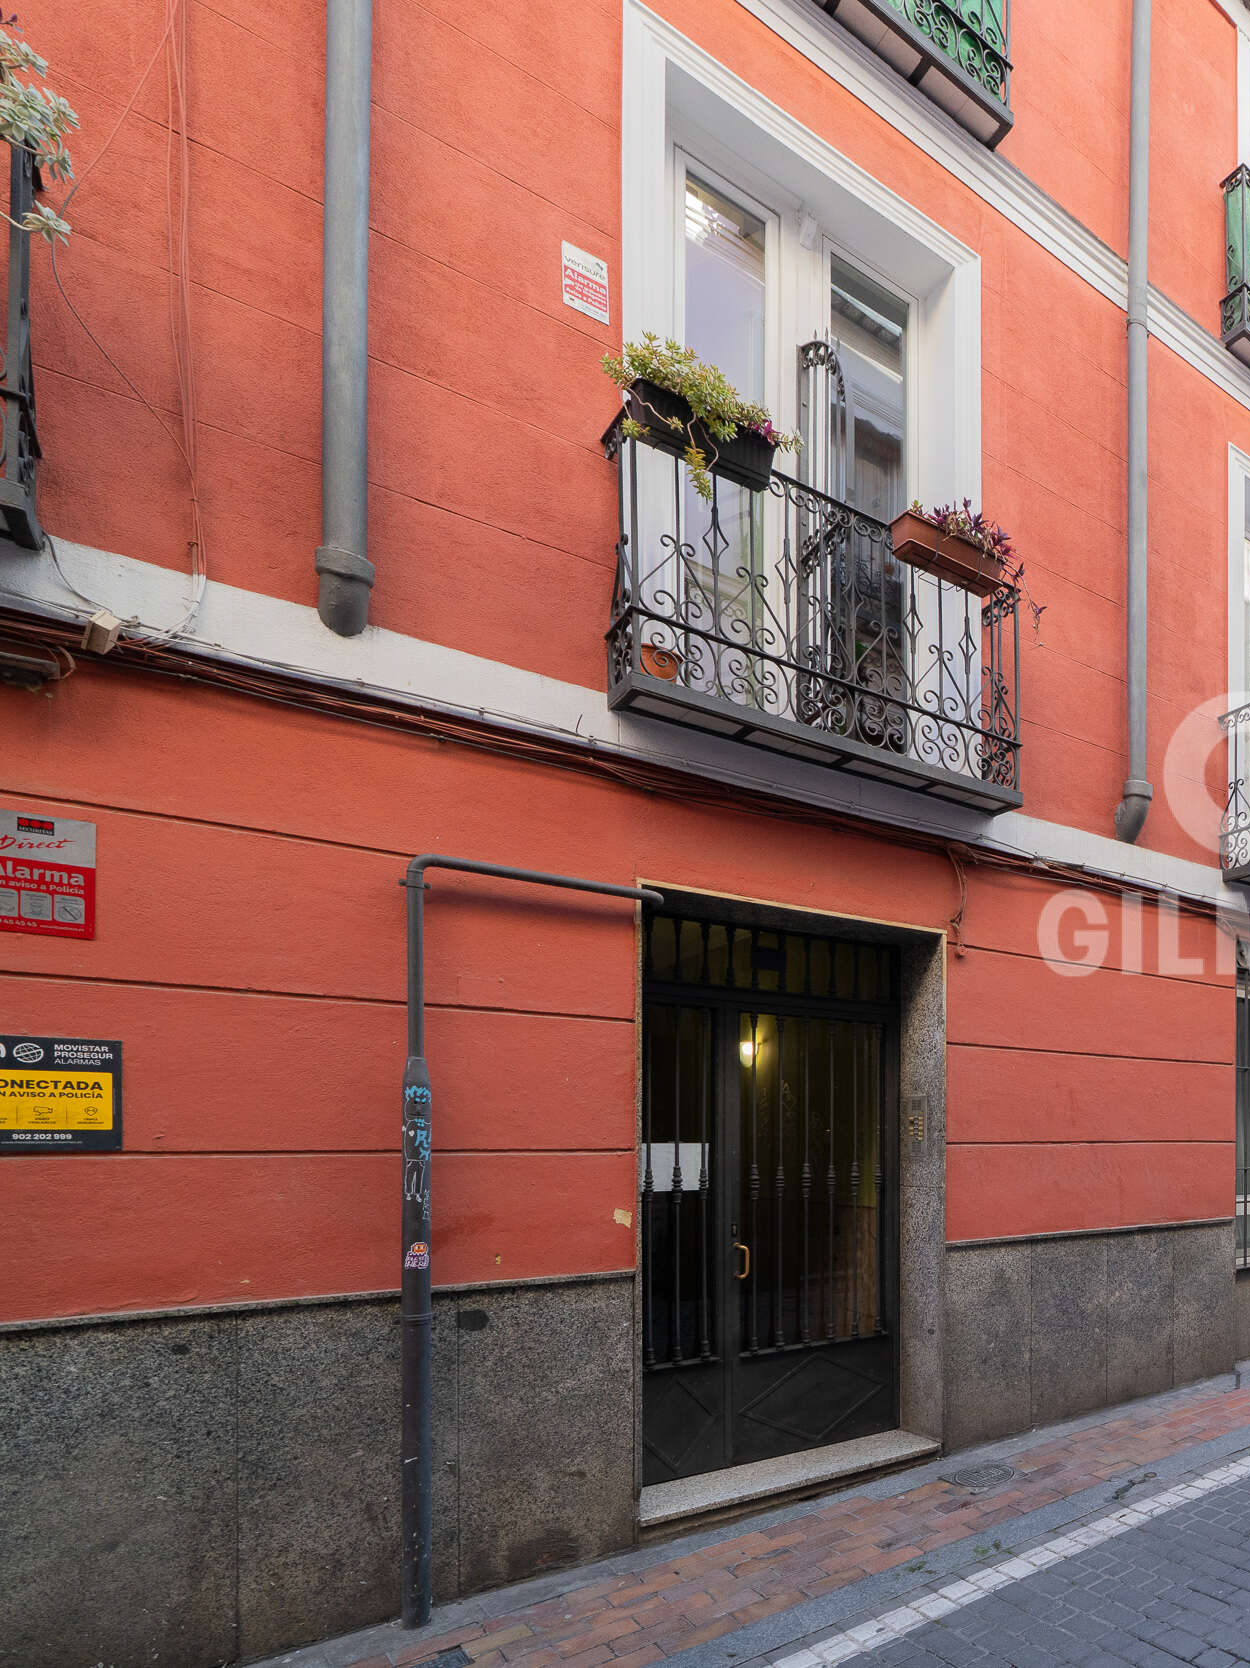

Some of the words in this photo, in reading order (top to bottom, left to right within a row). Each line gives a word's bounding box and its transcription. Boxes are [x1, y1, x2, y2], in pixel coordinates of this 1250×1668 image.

[8, 880, 38, 889] aviso
[54, 1044, 109, 1052] MOVISTAR
[54, 1051, 113, 1060] PROSEGUR
